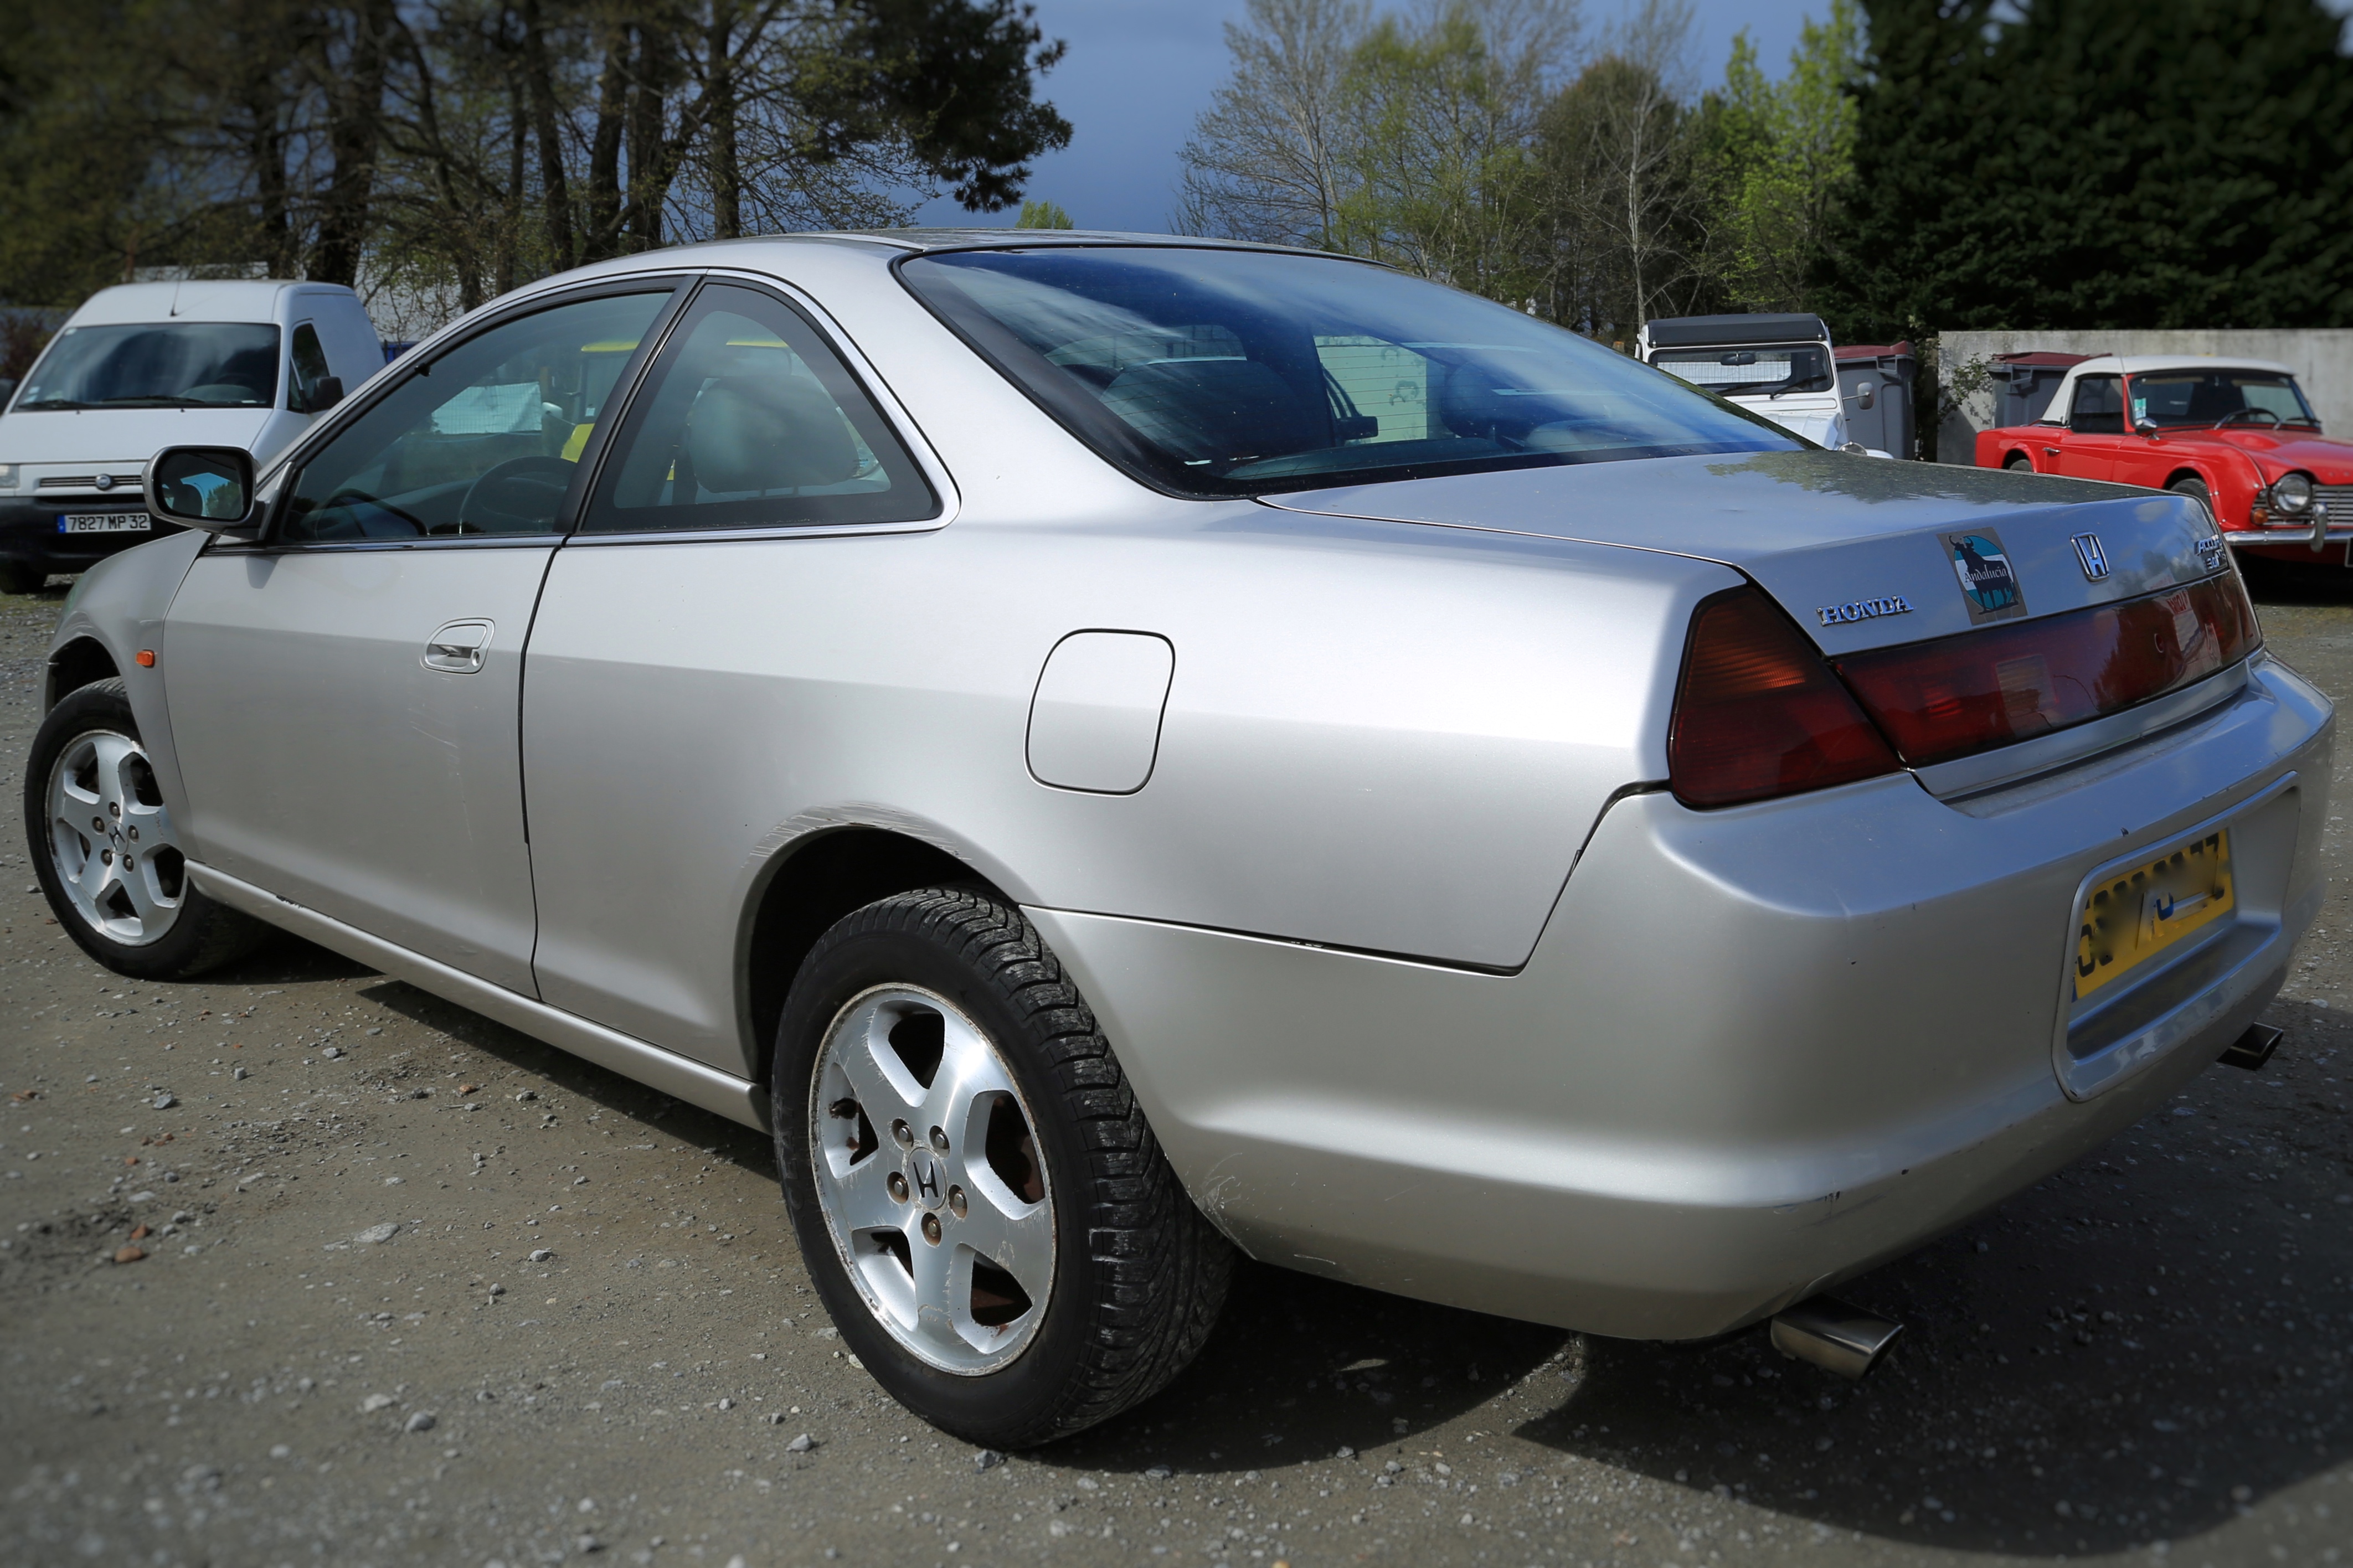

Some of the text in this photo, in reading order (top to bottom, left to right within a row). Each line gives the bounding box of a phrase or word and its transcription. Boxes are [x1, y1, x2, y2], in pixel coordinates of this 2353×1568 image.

[69, 515, 148, 530] 7827 MP 32
[1965, 564, 2007, 582] Andalucia
[1816, 595, 1914, 626] HONDA
